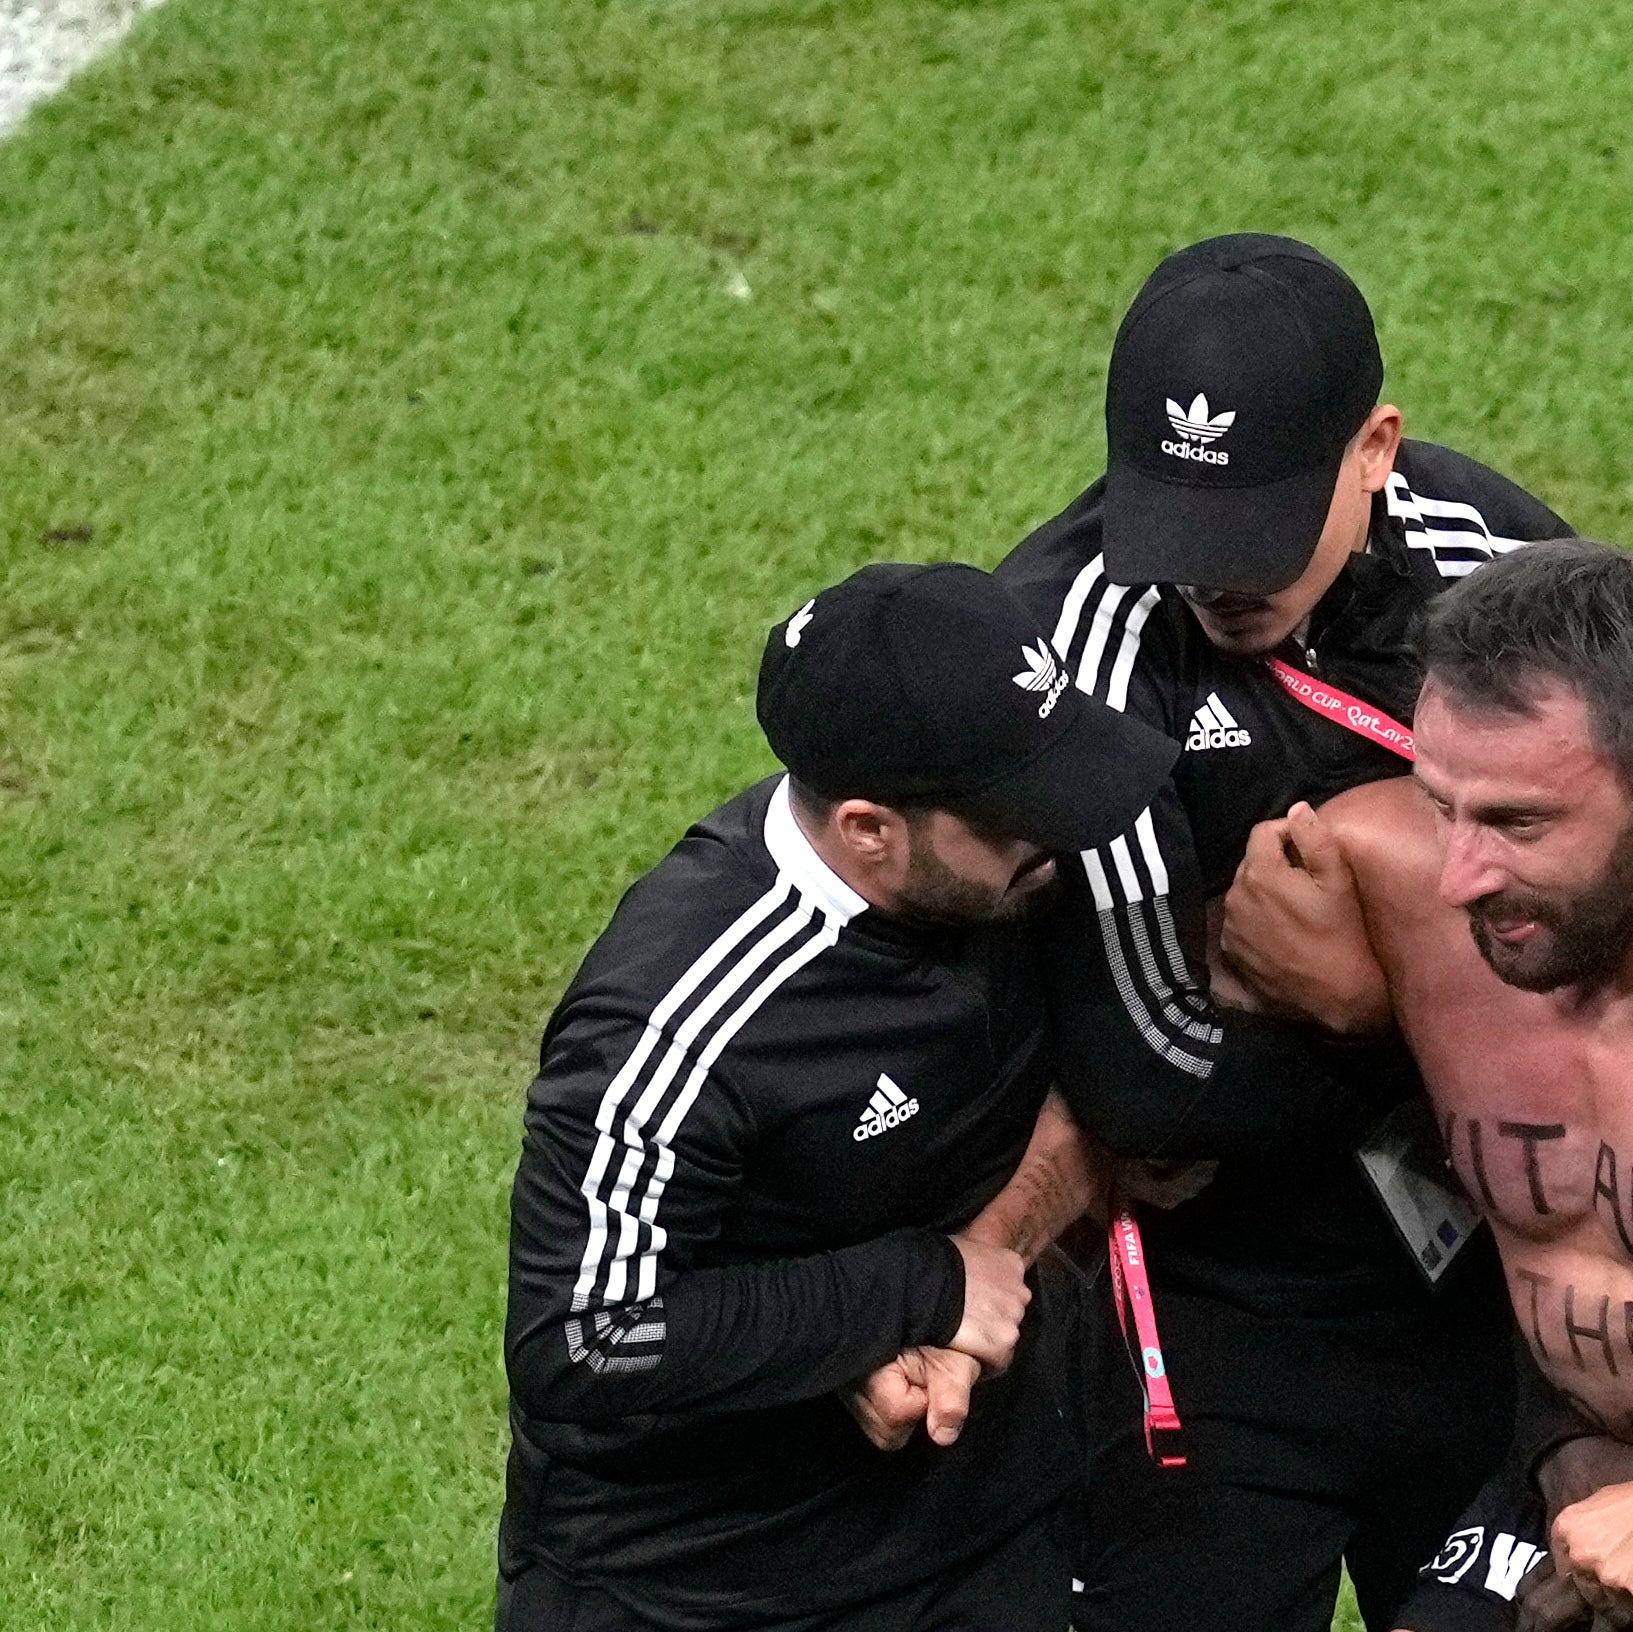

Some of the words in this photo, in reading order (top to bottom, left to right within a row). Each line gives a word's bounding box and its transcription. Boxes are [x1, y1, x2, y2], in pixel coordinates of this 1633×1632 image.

[1161, 440, 1229, 465] adidas
[1312, 691, 1341, 711] CUP
[852, 1098, 920, 1142] adidas
[1124, 1231, 1140, 1265] FIFA
